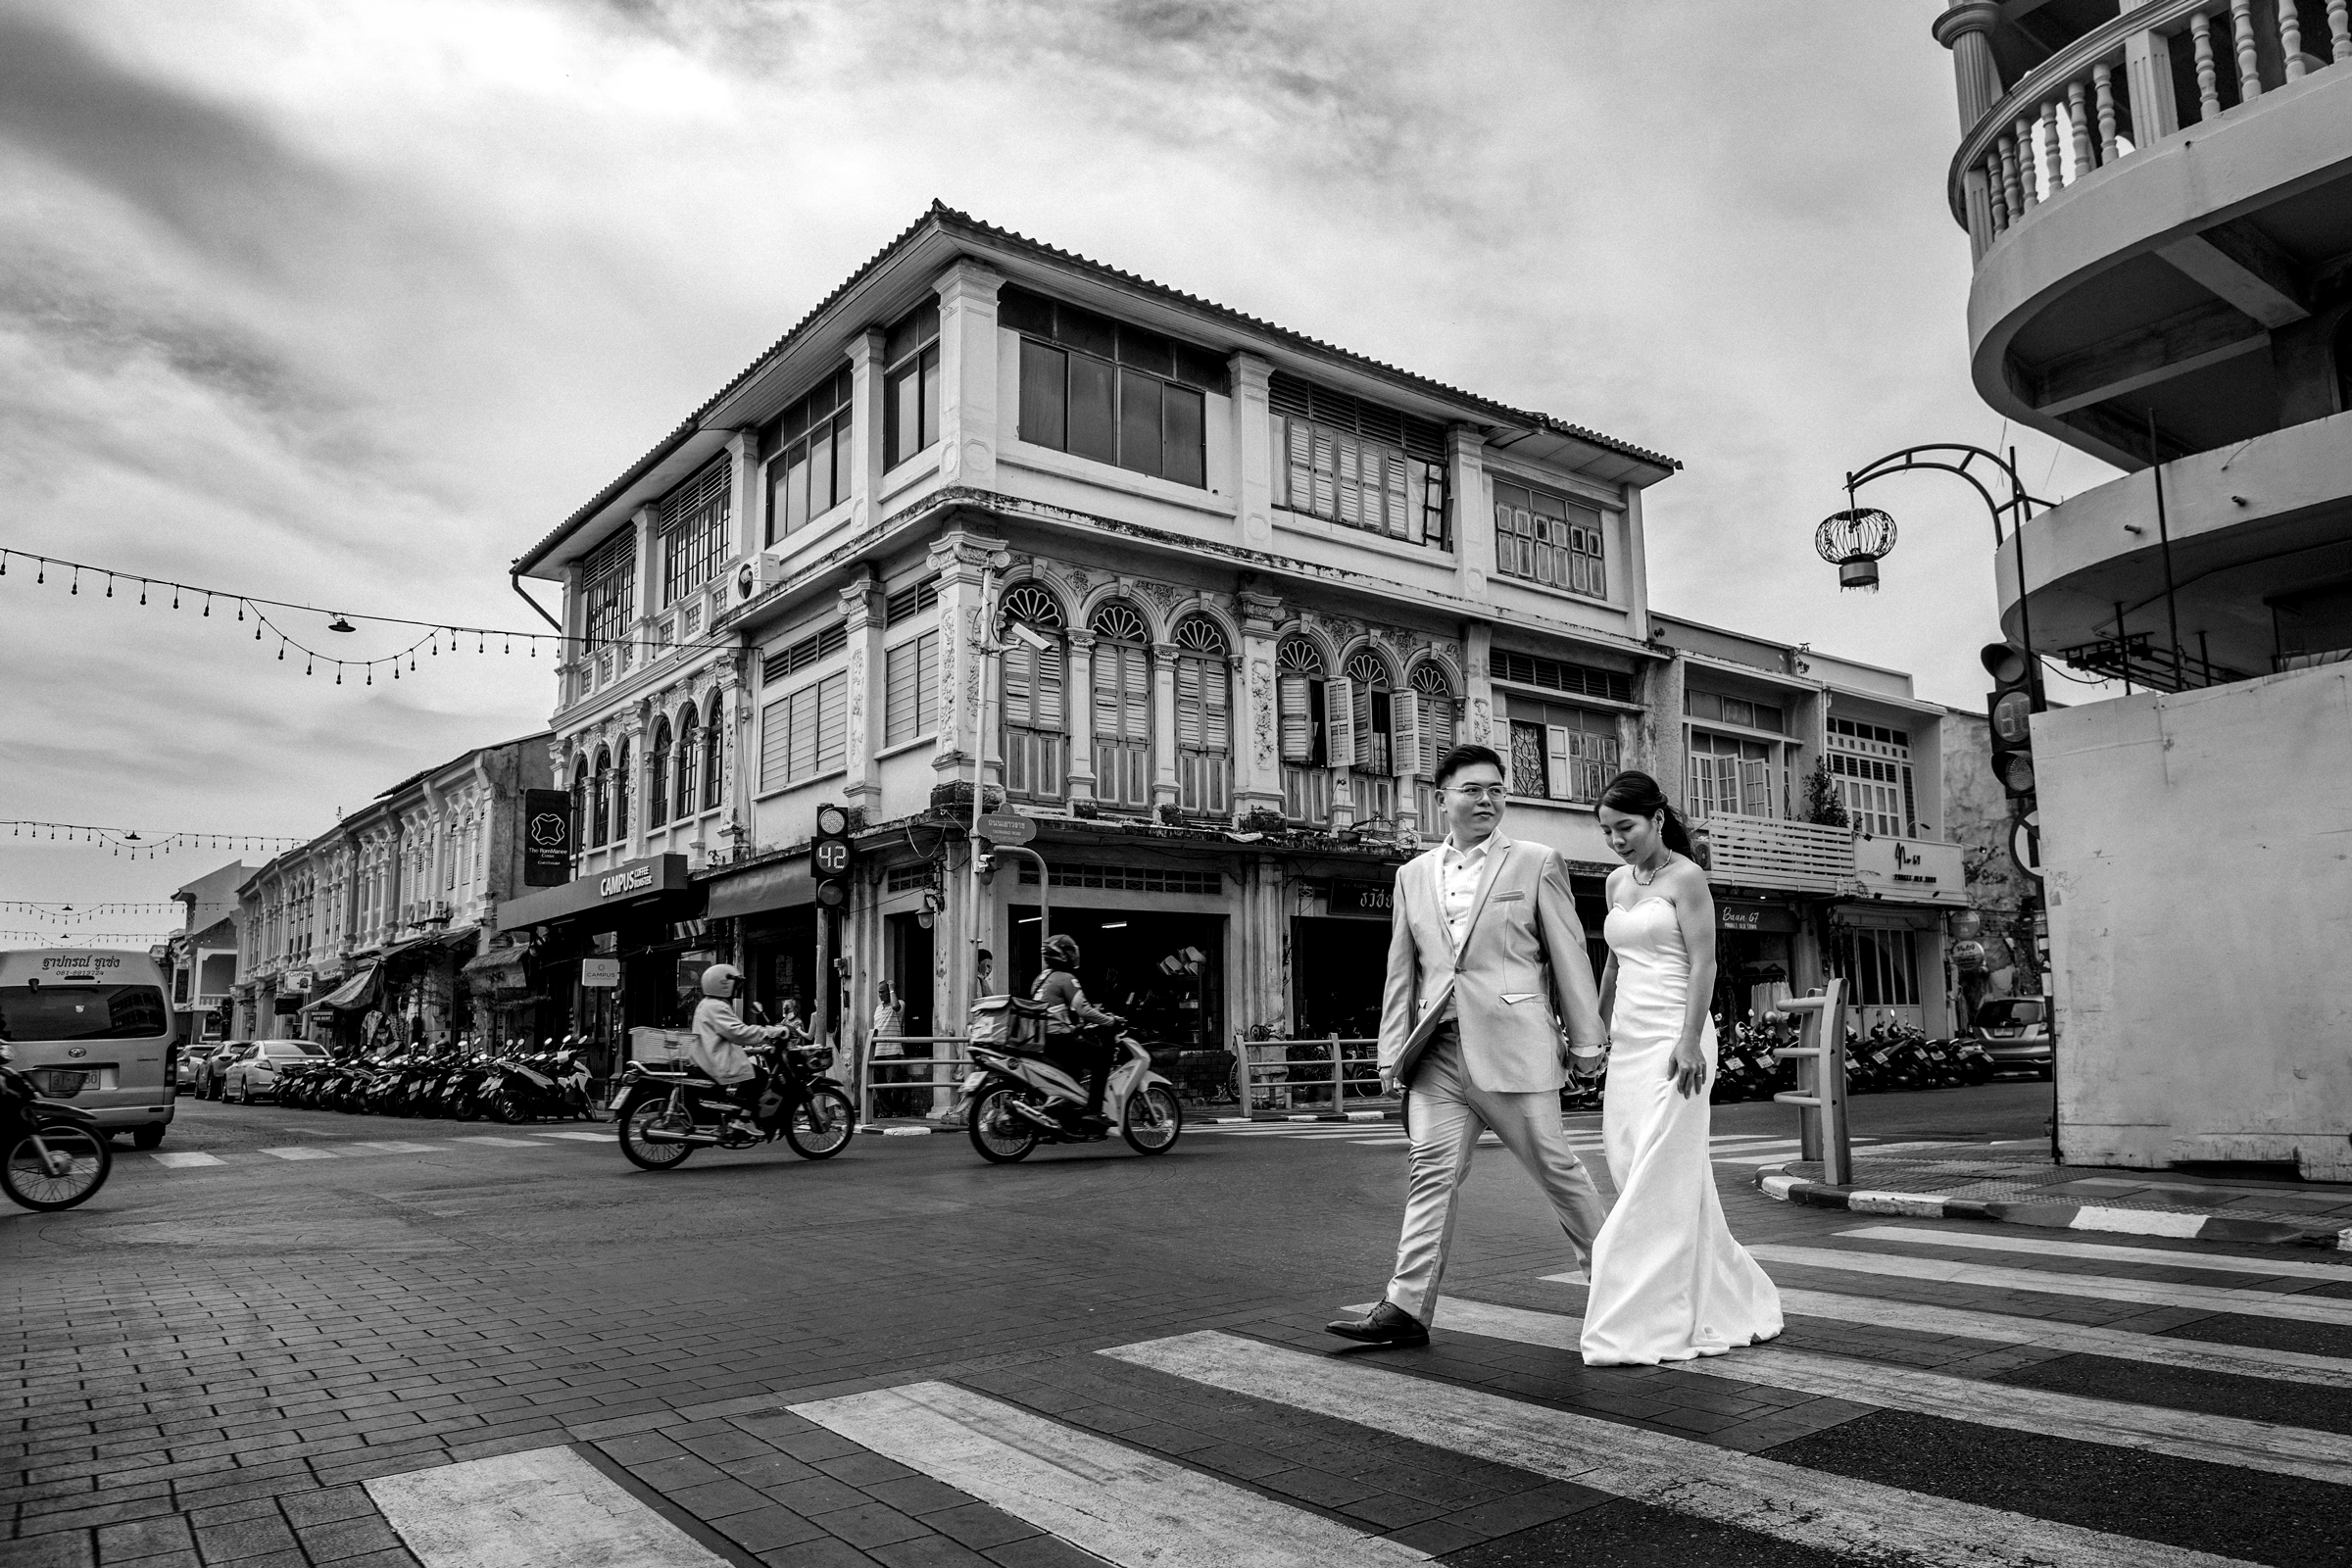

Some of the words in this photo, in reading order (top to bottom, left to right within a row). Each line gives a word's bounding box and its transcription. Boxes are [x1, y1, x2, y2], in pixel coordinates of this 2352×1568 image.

[818, 846, 847, 869] 42
[600, 870, 635, 897] CAMPUS
[634, 865, 650, 877] COFFEE
[1722, 906, 1746, 922] Baan
[1748, 911, 1760, 923] 67
[41, 954, 93, 971] ฐาปกรณ์
